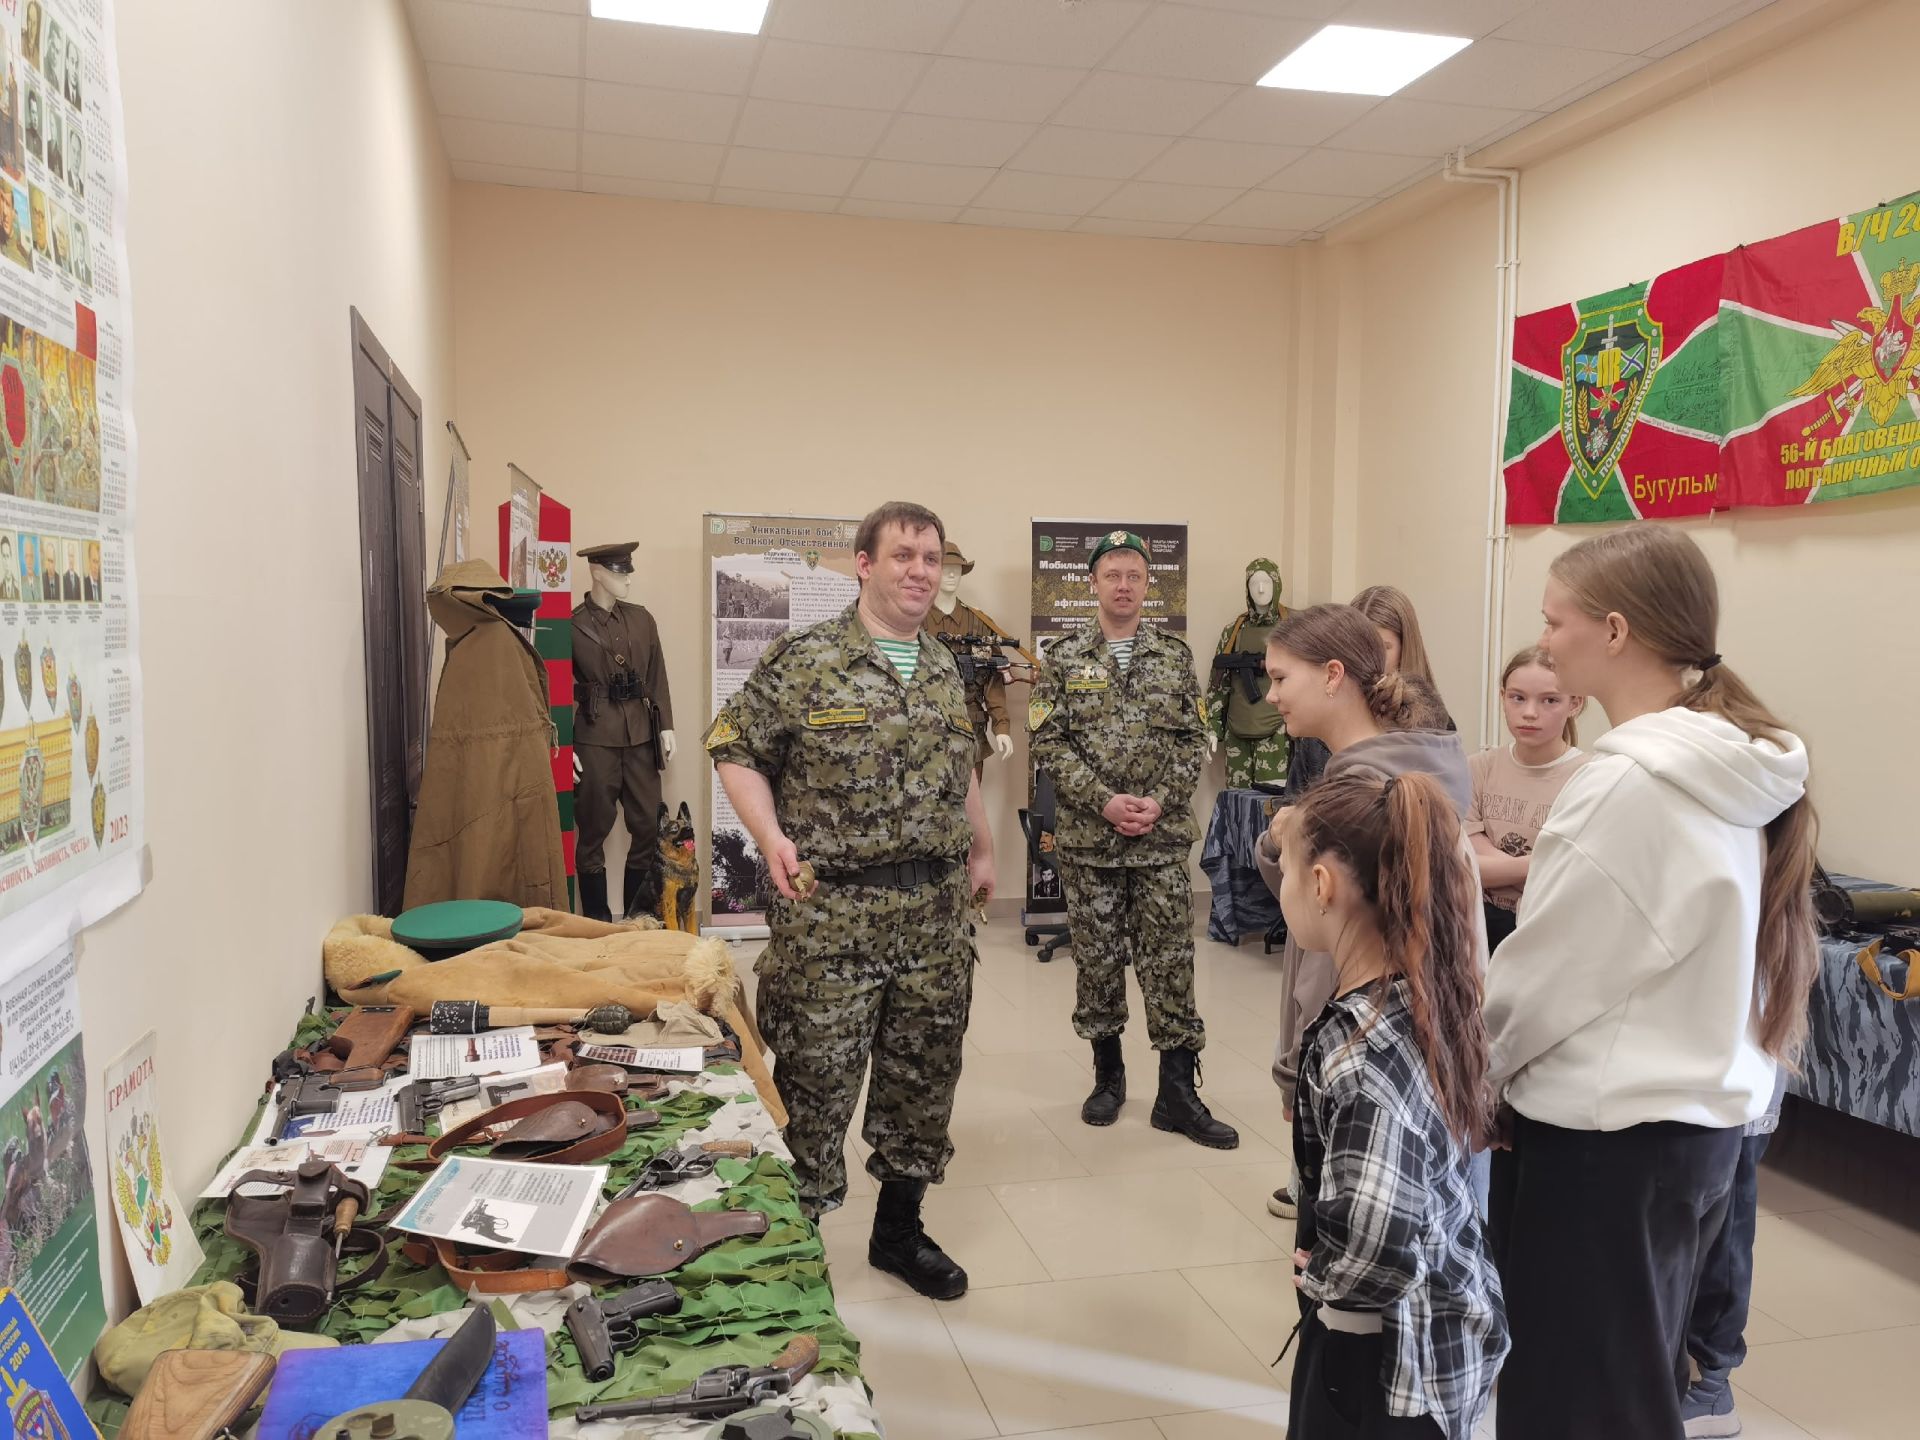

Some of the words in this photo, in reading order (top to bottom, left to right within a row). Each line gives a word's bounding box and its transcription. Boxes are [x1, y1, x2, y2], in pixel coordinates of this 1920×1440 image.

[1836, 210, 1893, 257] В/Ч
[1563, 365, 1588, 479] СОДРУЖЕСТВО
[1599, 347, 1659, 478] ПОГРАНИЧНИКОВ
[1780, 437, 1817, 465] 56-Й
[1785, 447, 1909, 490] ПОГРАНИЧНЫЙ
[1909, 446, 1920, 469] О
[1633, 472, 1718, 505] Бугульм
[1142, 600, 1164, 608] нит»
[110, 814, 129, 844] 2023
[108, 1056, 154, 1113] ГРАМОТА
[9, 1341, 31, 1372] 2019
